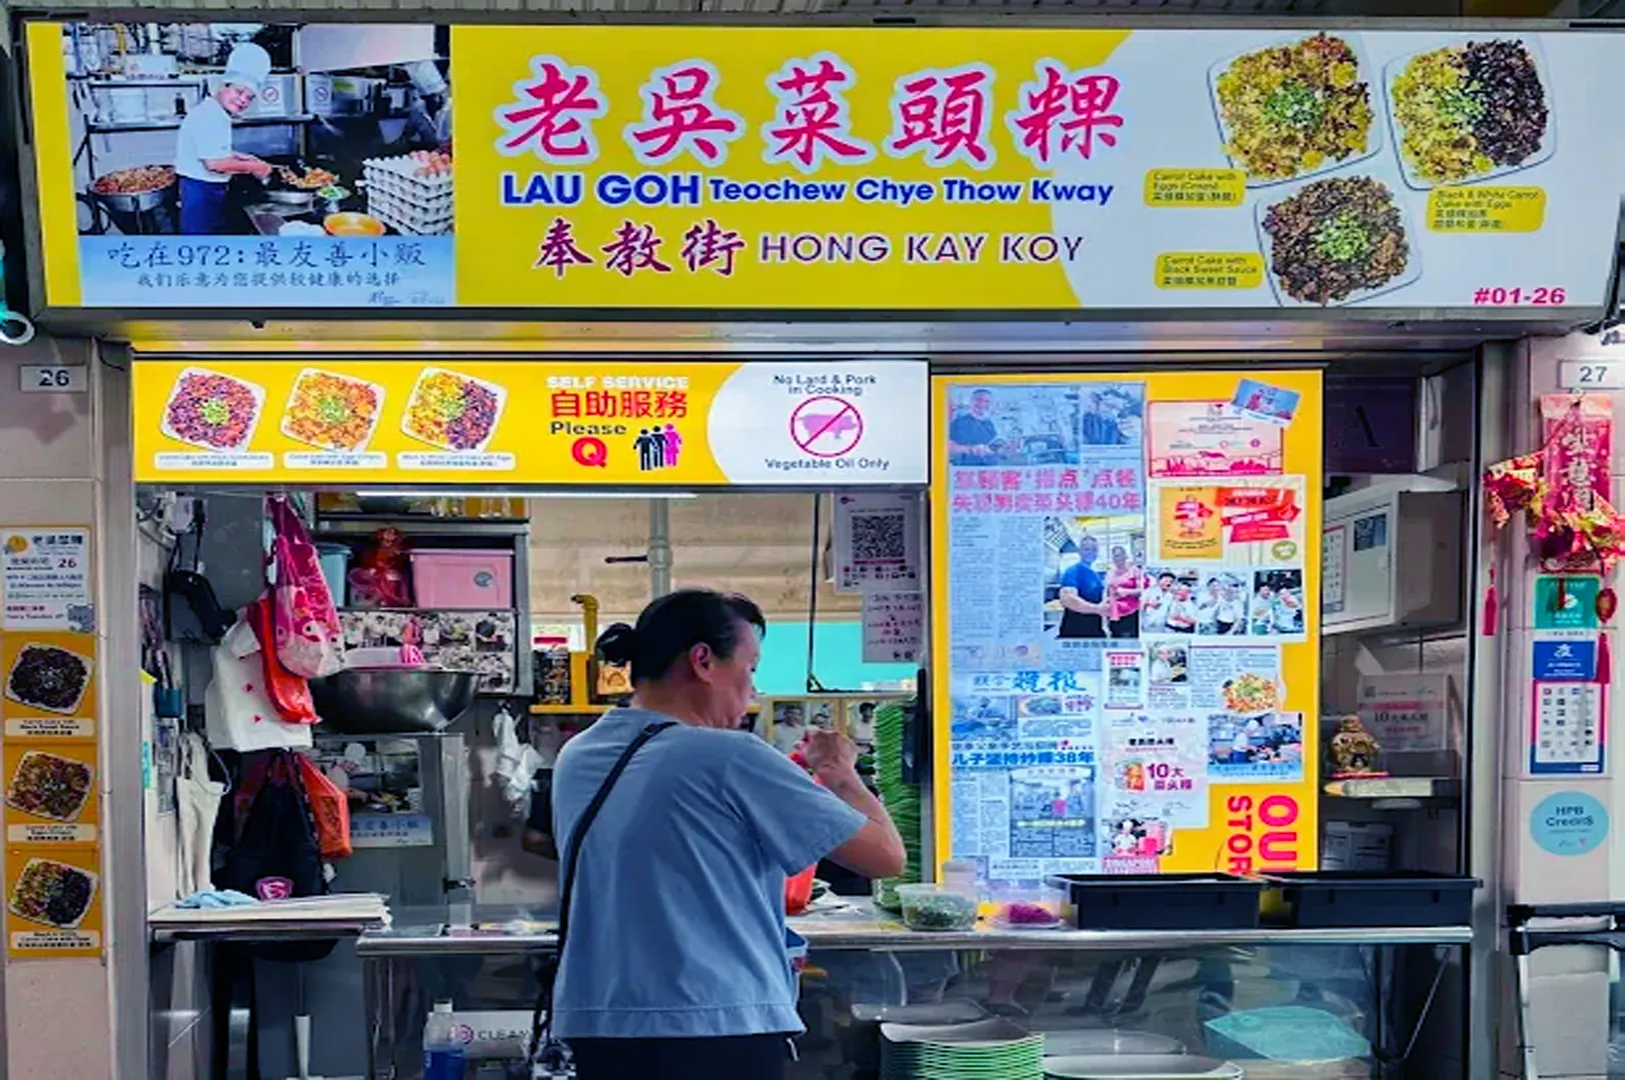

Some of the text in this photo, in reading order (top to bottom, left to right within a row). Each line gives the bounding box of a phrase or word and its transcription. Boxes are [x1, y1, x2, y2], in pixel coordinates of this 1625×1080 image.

[504, 59, 1124, 165] 老吳菜頭粿
[1188, 172, 1213, 180] Cake
[503, 175, 1113, 205] LAU GOH Teochew Chye Thow Kway
[537, 218, 744, 276] 奉教街
[762, 236, 1083, 261] HONG KAY KOY
[1474, 287, 1566, 304] #01-26
[39, 370, 70, 387] 26
[547, 376, 689, 388] SELF SERVICE
[773, 374, 877, 384] No Lard & Pork
[1579, 366, 1608, 382] 27
[805, 385, 863, 397] Cooking
[552, 389, 687, 418] 自助服務
[550, 421, 627, 435] Please
[571, 436, 608, 468] Q
[765, 458, 889, 471] Vegetable Oil Only
[58, 558, 77, 569] 26
[1556, 806, 1584, 815] HPB
[1258, 795, 1298, 872] OU
